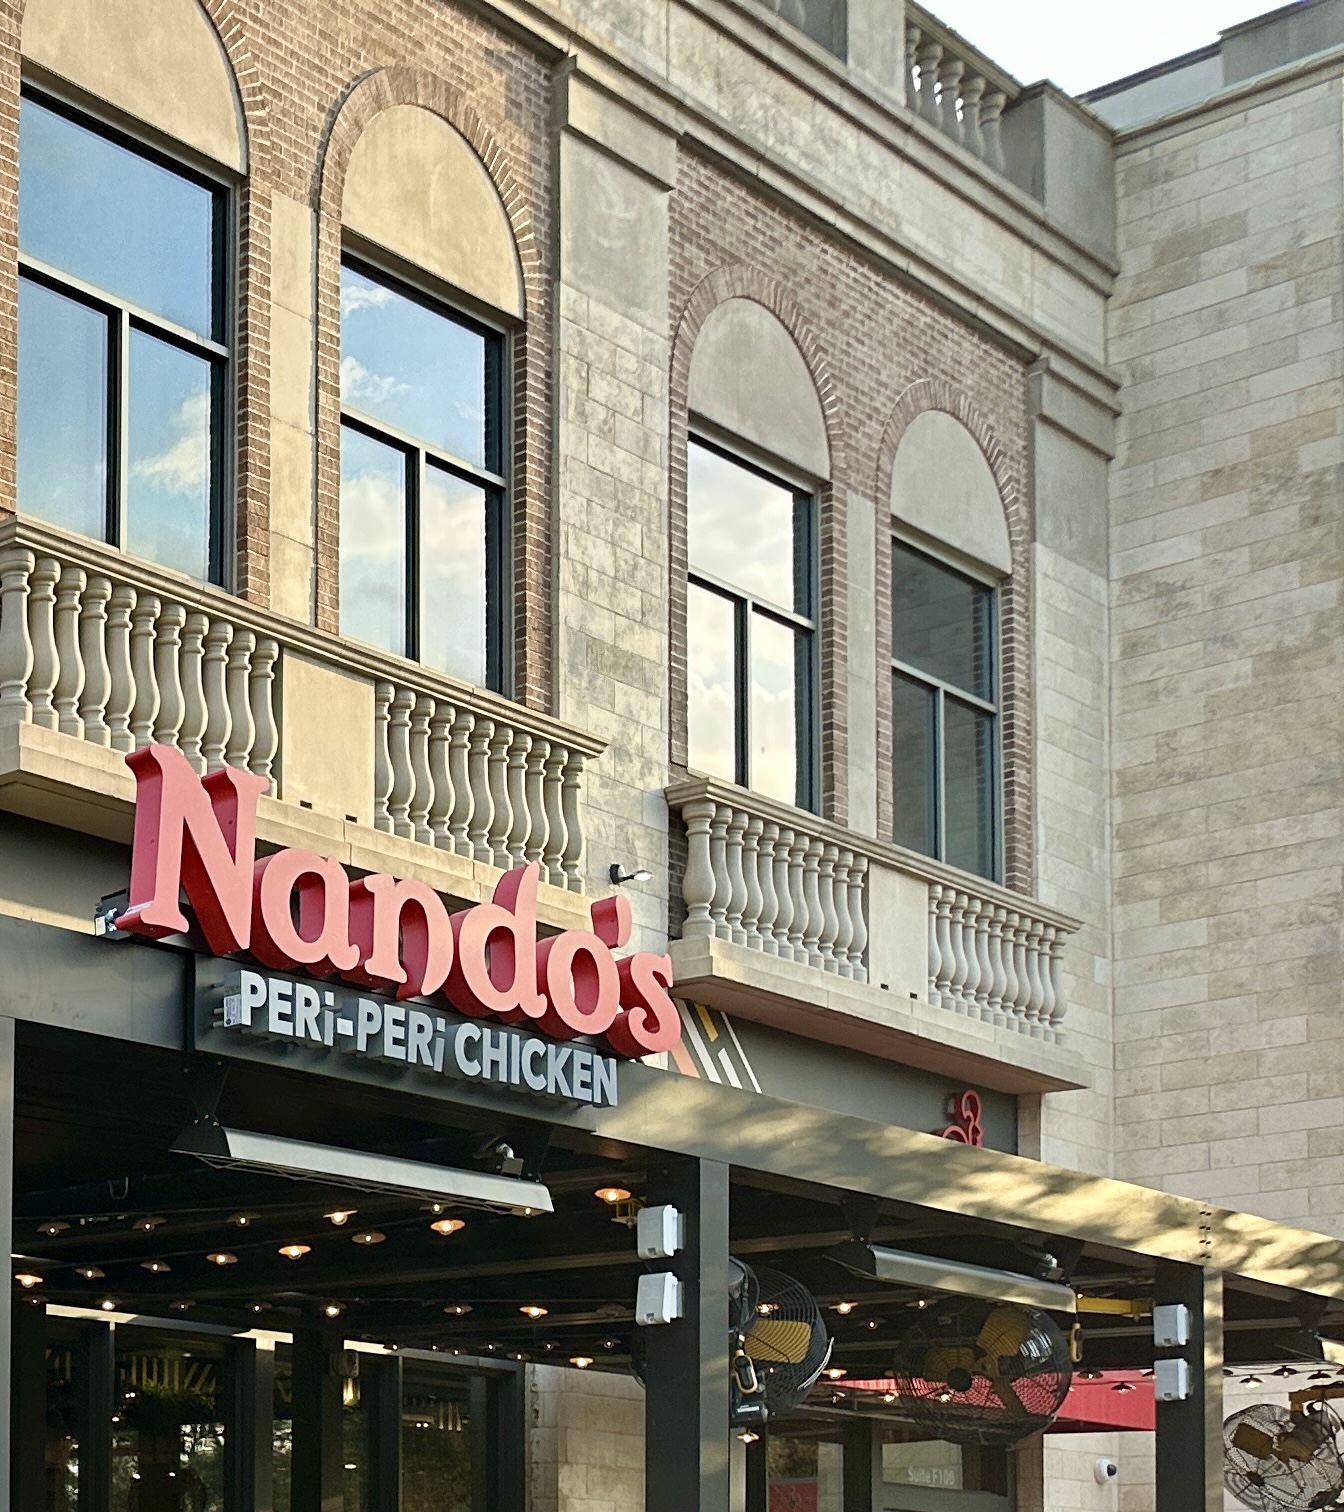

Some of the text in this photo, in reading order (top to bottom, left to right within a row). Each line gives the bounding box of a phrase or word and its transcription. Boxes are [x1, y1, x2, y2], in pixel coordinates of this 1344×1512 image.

[115, 743, 683, 1057] Nando's
[454, 1027, 619, 1108] CHICKEN
[907, 1466, 955, 1486] Suite F100
